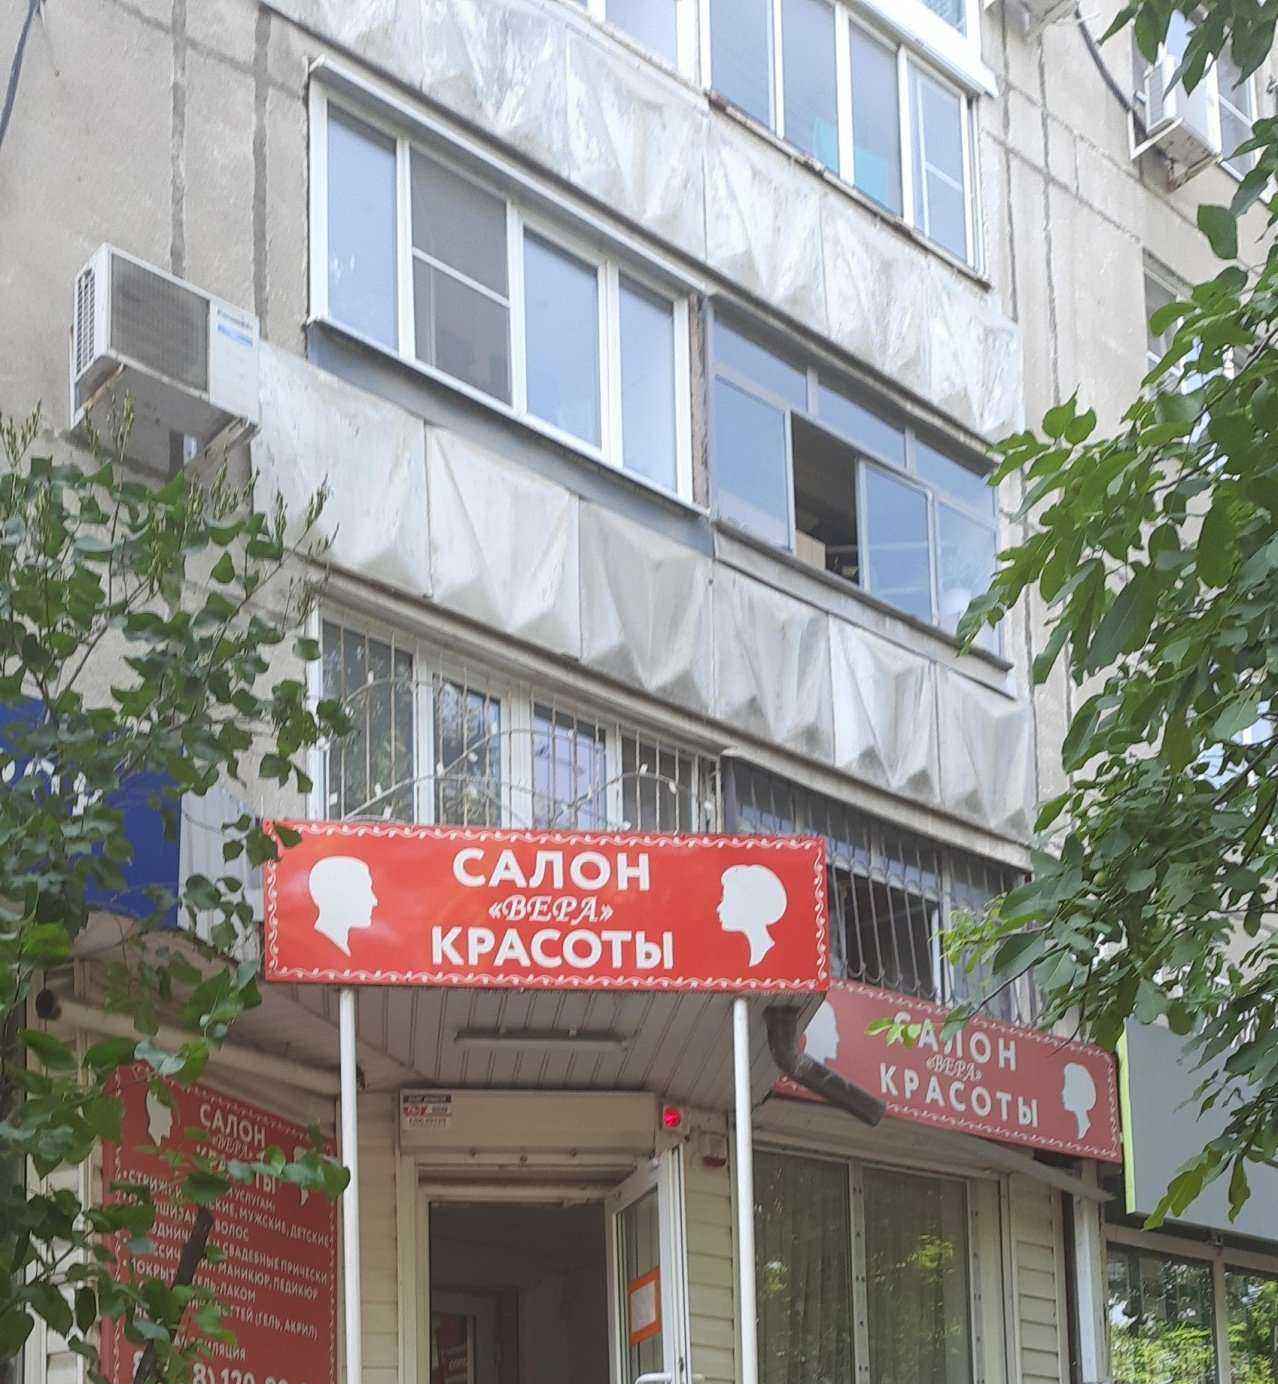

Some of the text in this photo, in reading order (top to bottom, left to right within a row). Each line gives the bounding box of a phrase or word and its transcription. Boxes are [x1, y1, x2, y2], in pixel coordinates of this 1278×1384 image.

[452, 847, 651, 892] САЛОН
[488, 894, 615, 926] «ВЕРА»
[431, 925, 674, 970] КРАСОТЫ
[926, 1053, 984, 1083] «ВЕРА»
[879, 1062, 1039, 1129] КРАСОТЫ
[199, 1103, 267, 1148] САЛОН
